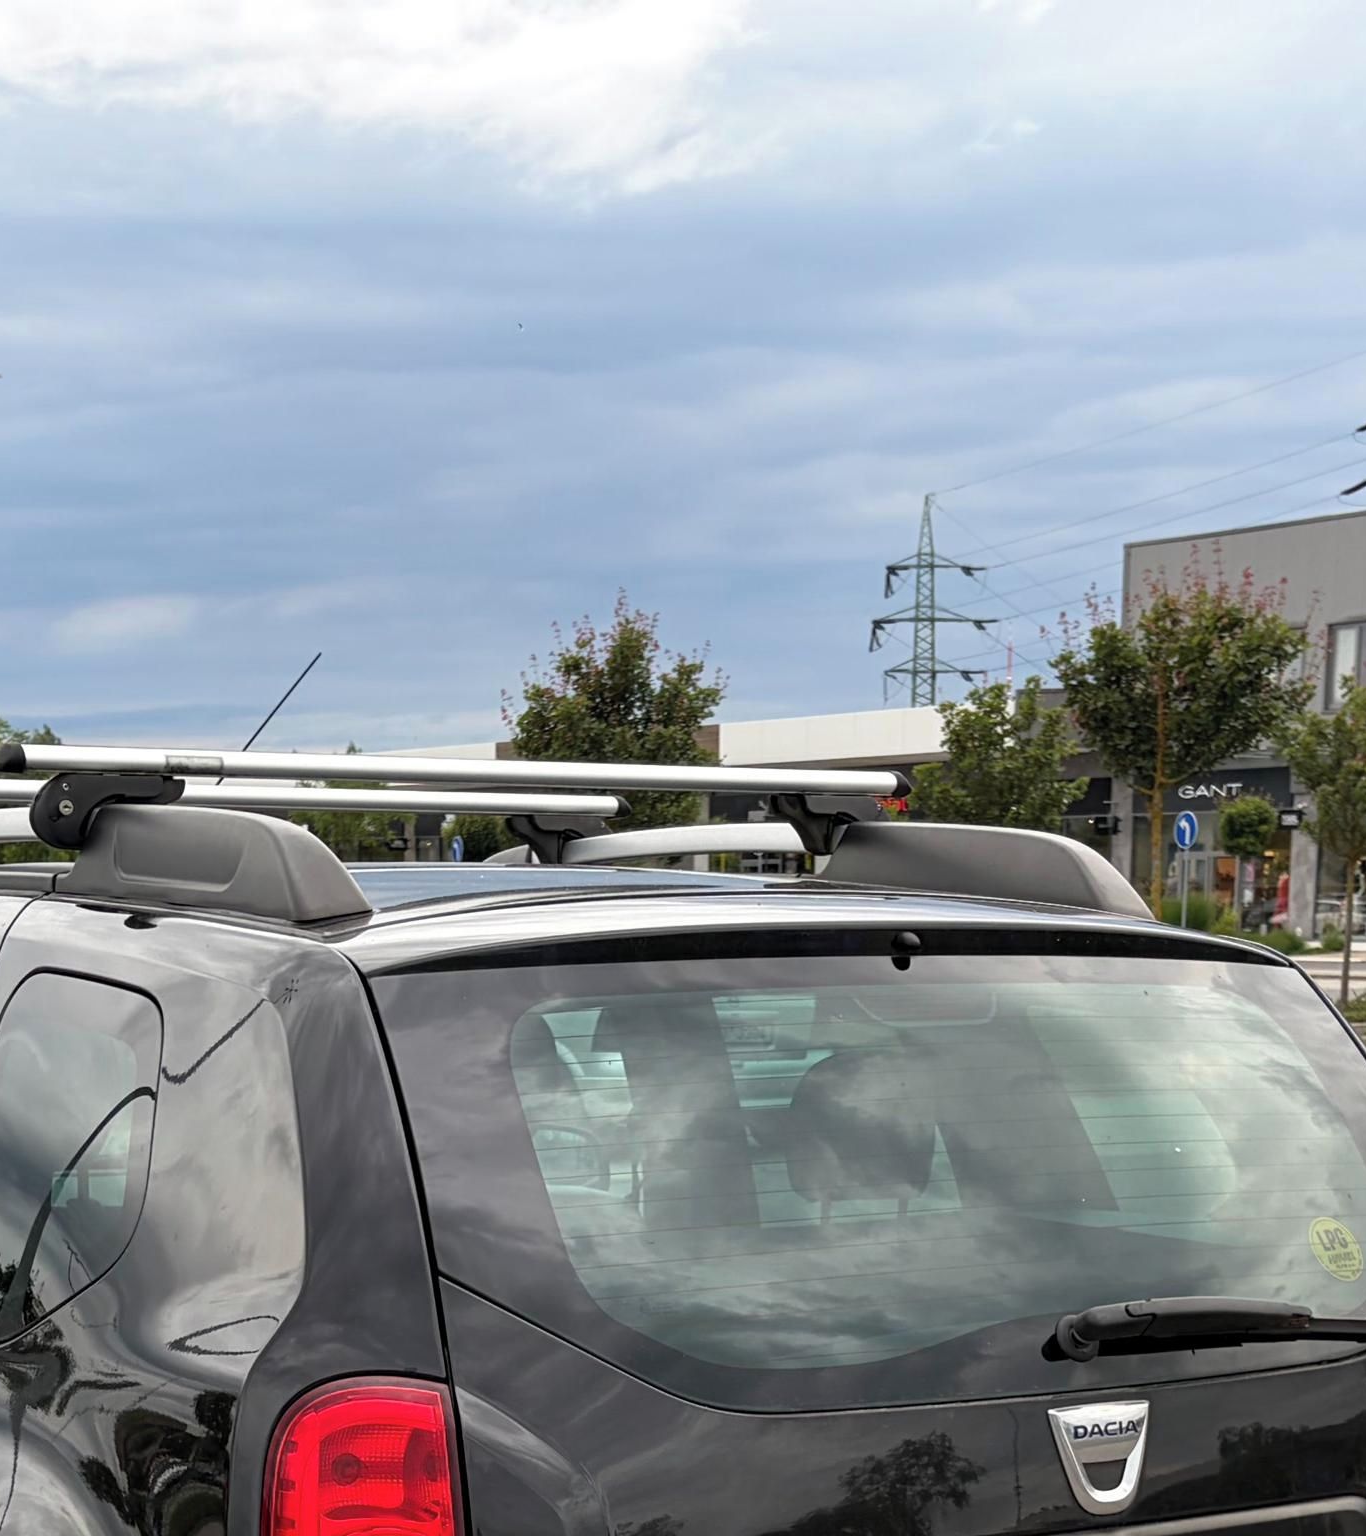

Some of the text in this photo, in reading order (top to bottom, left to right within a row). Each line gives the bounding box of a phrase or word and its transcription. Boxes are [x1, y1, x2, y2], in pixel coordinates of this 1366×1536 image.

[1177, 782, 1243, 799] GANT
[1316, 1227, 1349, 1251] LPG
[1073, 1420, 1139, 1441] DACIA
